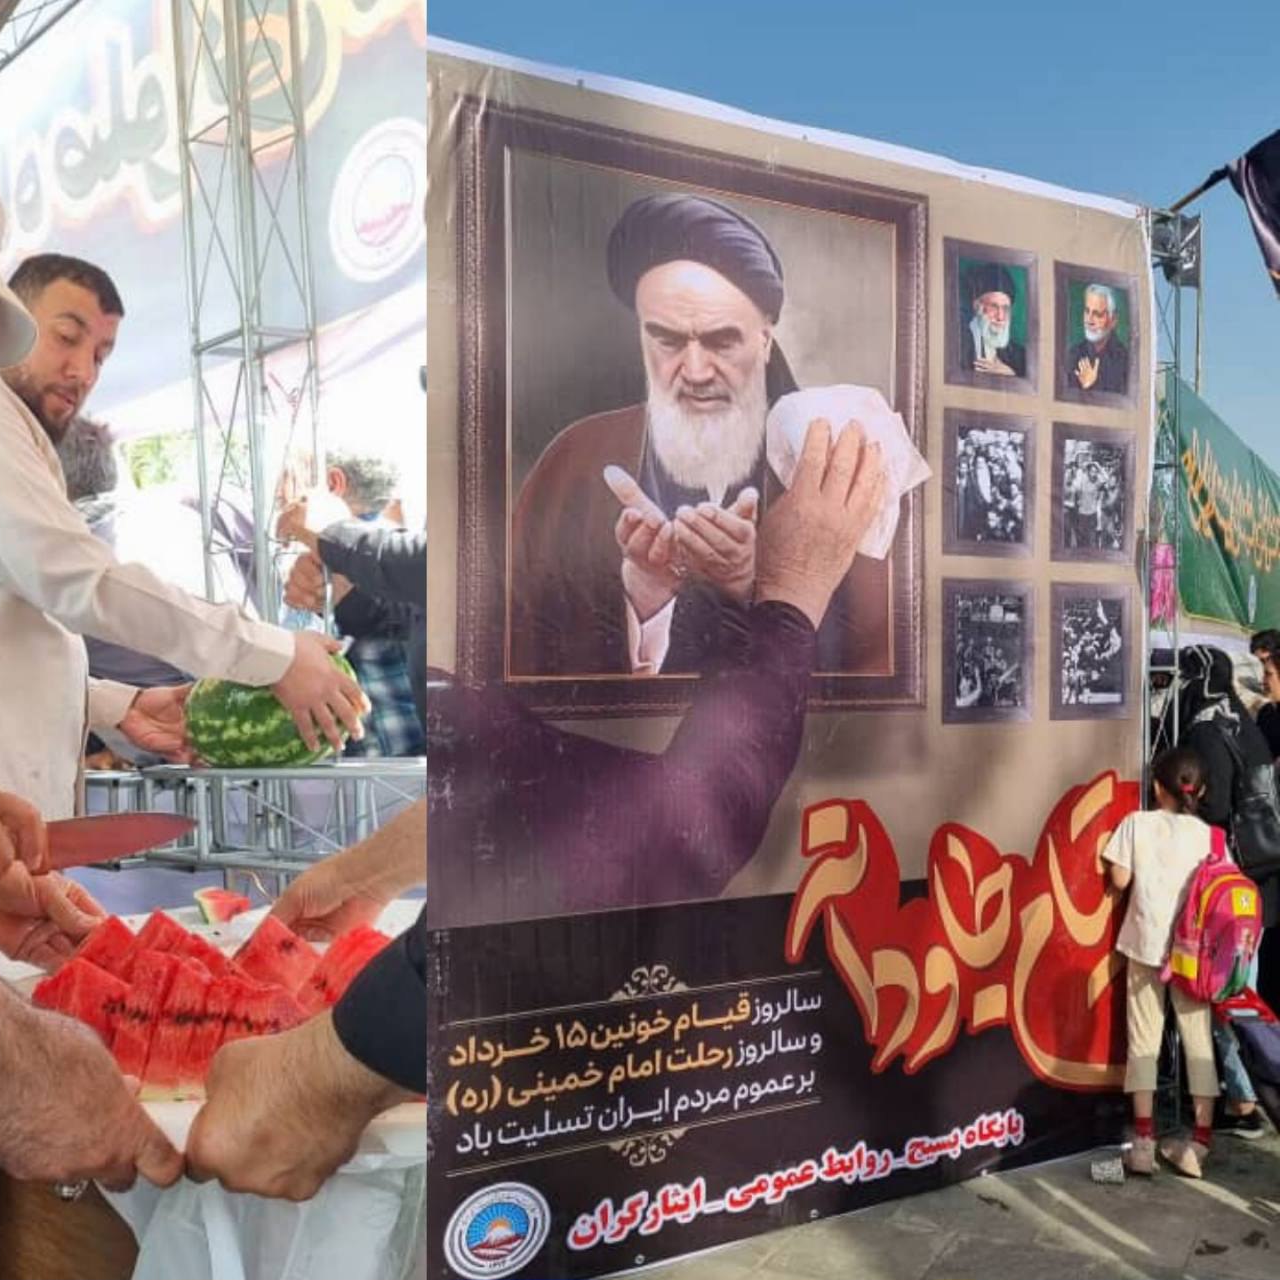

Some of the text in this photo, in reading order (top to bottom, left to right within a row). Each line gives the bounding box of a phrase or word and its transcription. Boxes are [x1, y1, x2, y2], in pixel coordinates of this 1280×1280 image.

[751, 988, 821, 1025] سالروز
[555, 1020, 587, 1049] ۱۵
[590, 1009, 671, 1049] خونین
[735, 1029, 806, 1067] سالروز
[608, 1050, 660, 1093] امام
[666, 1042, 734, 1069] رحلت
[508, 1061, 603, 1107] خمینی
[674, 1086, 730, 1121] مردم
[734, 1075, 795, 1110] عموم
[497, 1104, 594, 1147] تسلیت
[598, 1088, 669, 1131] ایران
[456, 1122, 492, 1155] باد
[820, 1140, 893, 1184] روابط
[725, 1159, 818, 1211] عمومی
